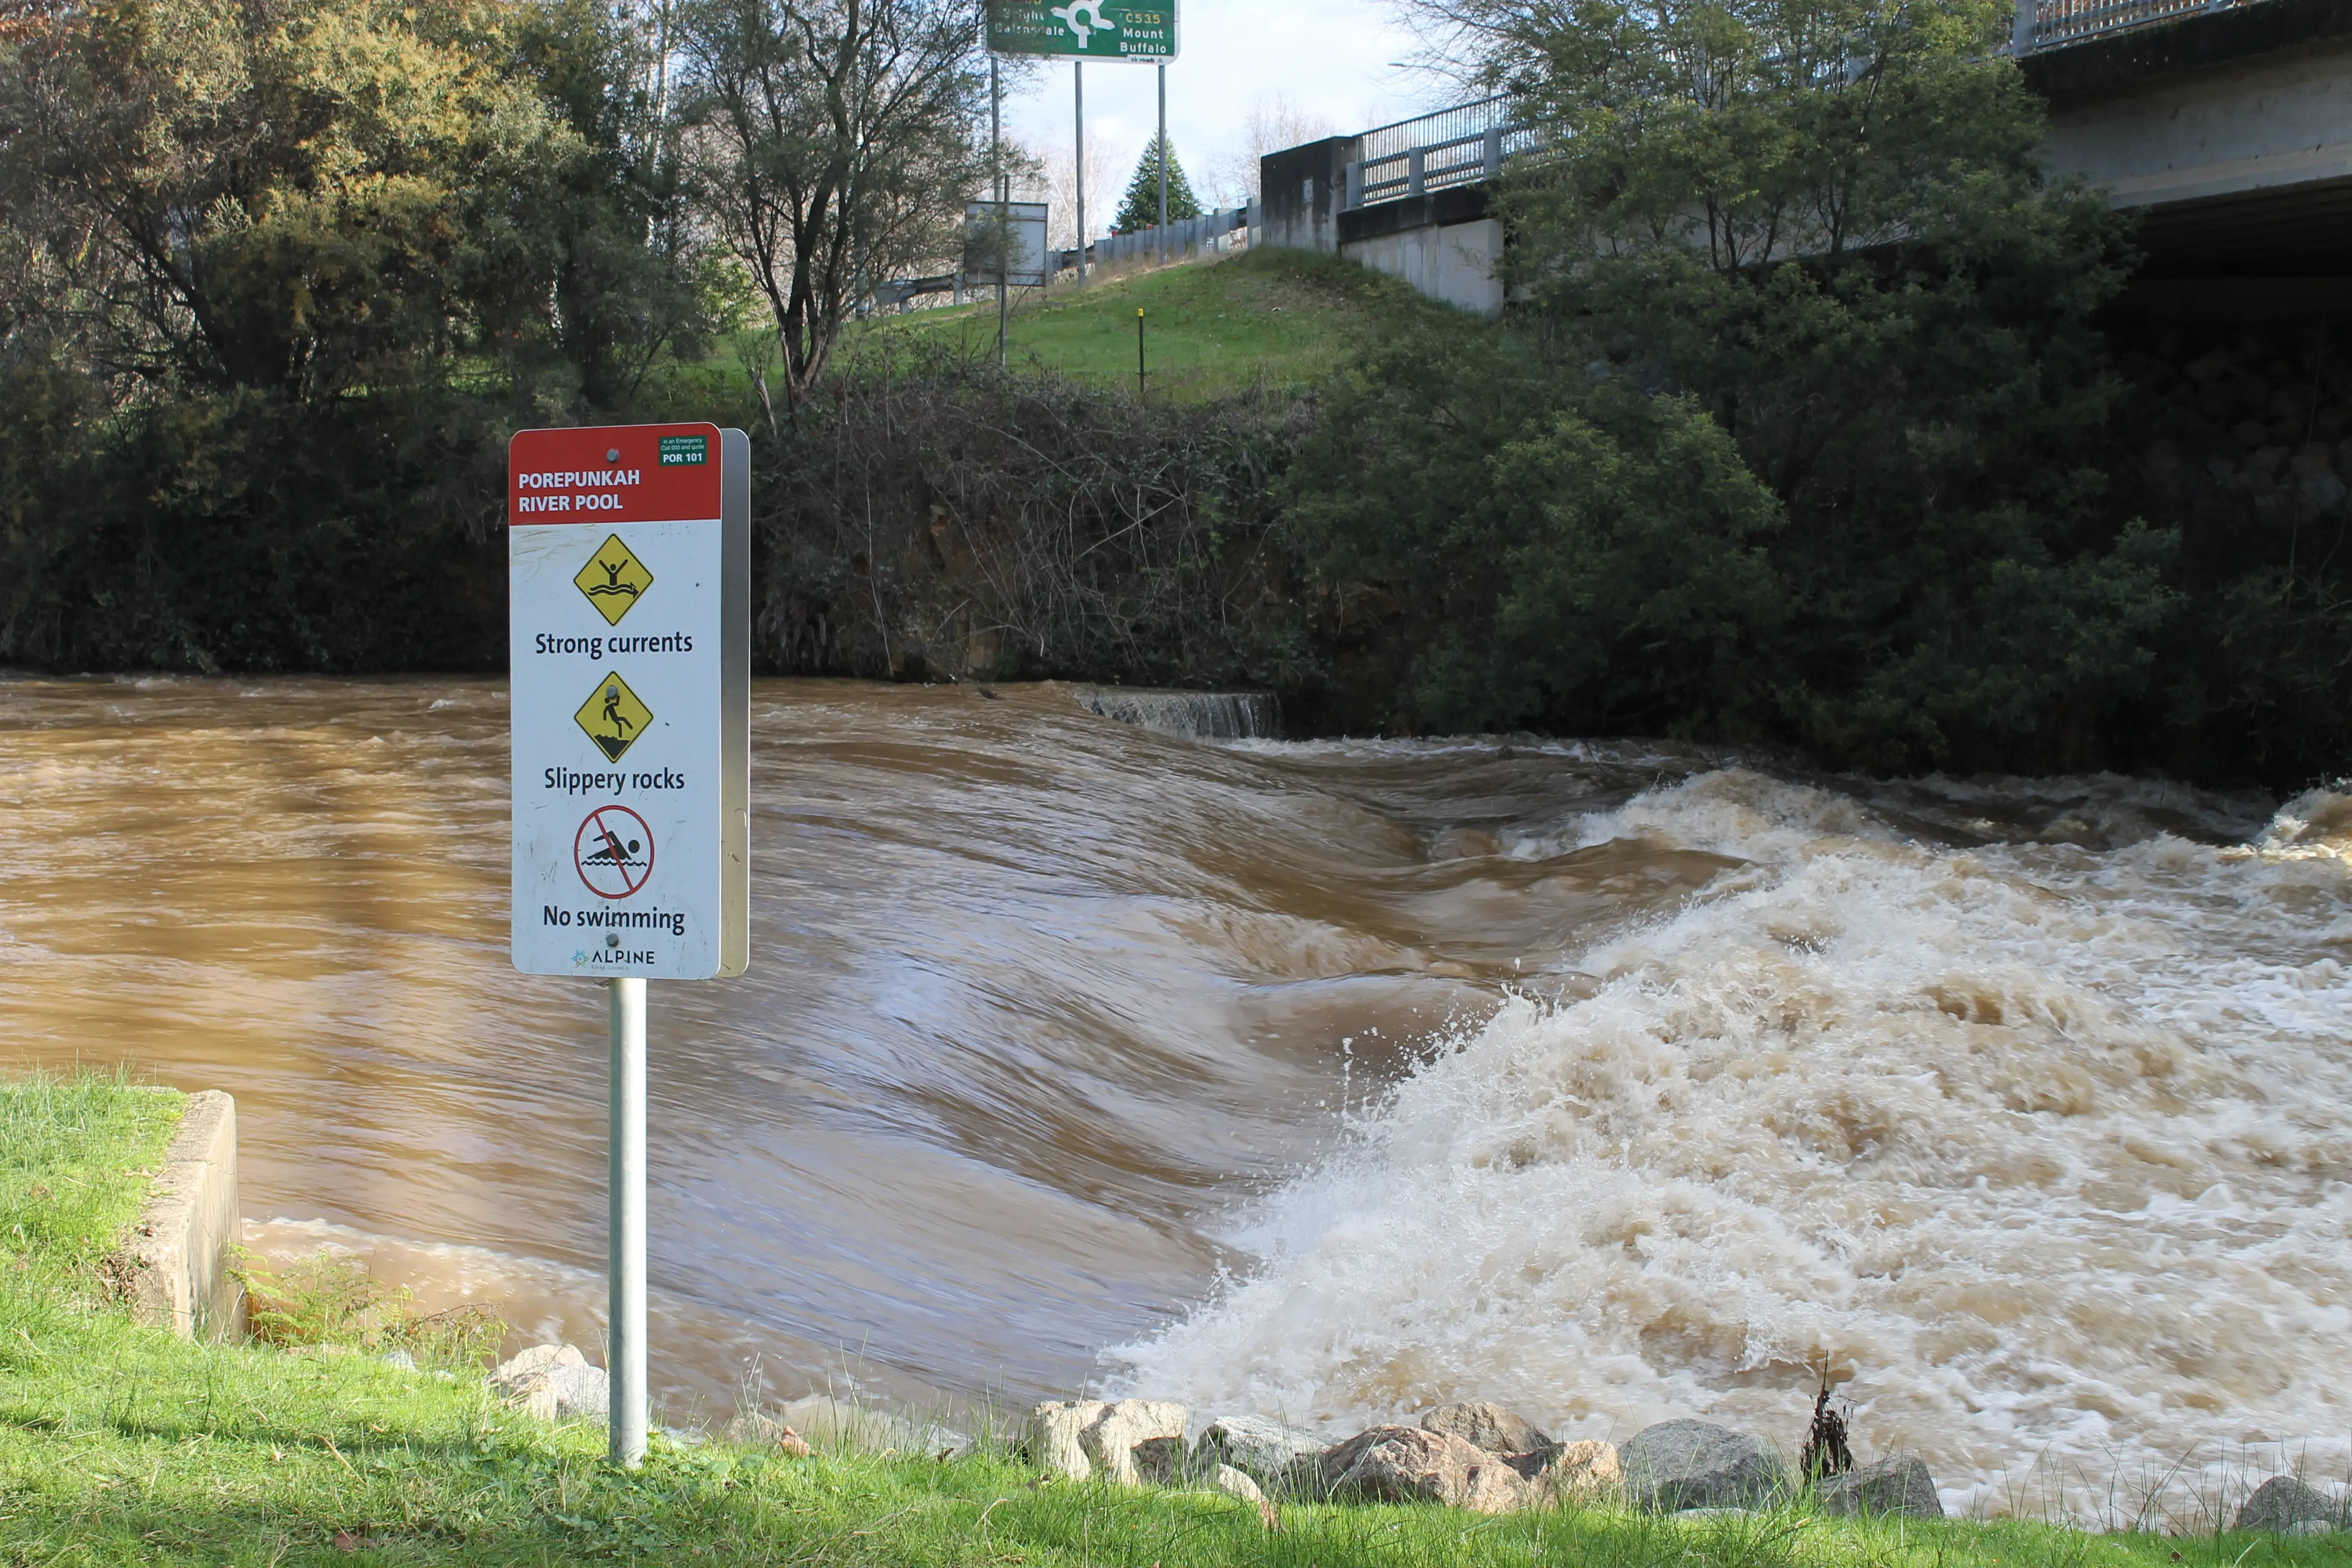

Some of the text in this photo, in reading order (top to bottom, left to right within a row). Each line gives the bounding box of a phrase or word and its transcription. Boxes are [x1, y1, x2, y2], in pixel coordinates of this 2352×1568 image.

[1003, 8, 1044, 23] Bight
[1126, 13, 1160, 24] C535
[1123, 27, 1164, 40] Mount
[1120, 42, 1166, 54] Buffalo
[663, 453, 703, 462] POR 101
[519, 469, 640, 489] POREPUNKAH
[519, 494, 623, 512] RIVER POOL
[535, 631, 693, 660] Strong currents
[544, 767, 685, 796] Slippery rocks
[544, 905, 685, 936] No swimming
[592, 949, 655, 965] ALPINE
